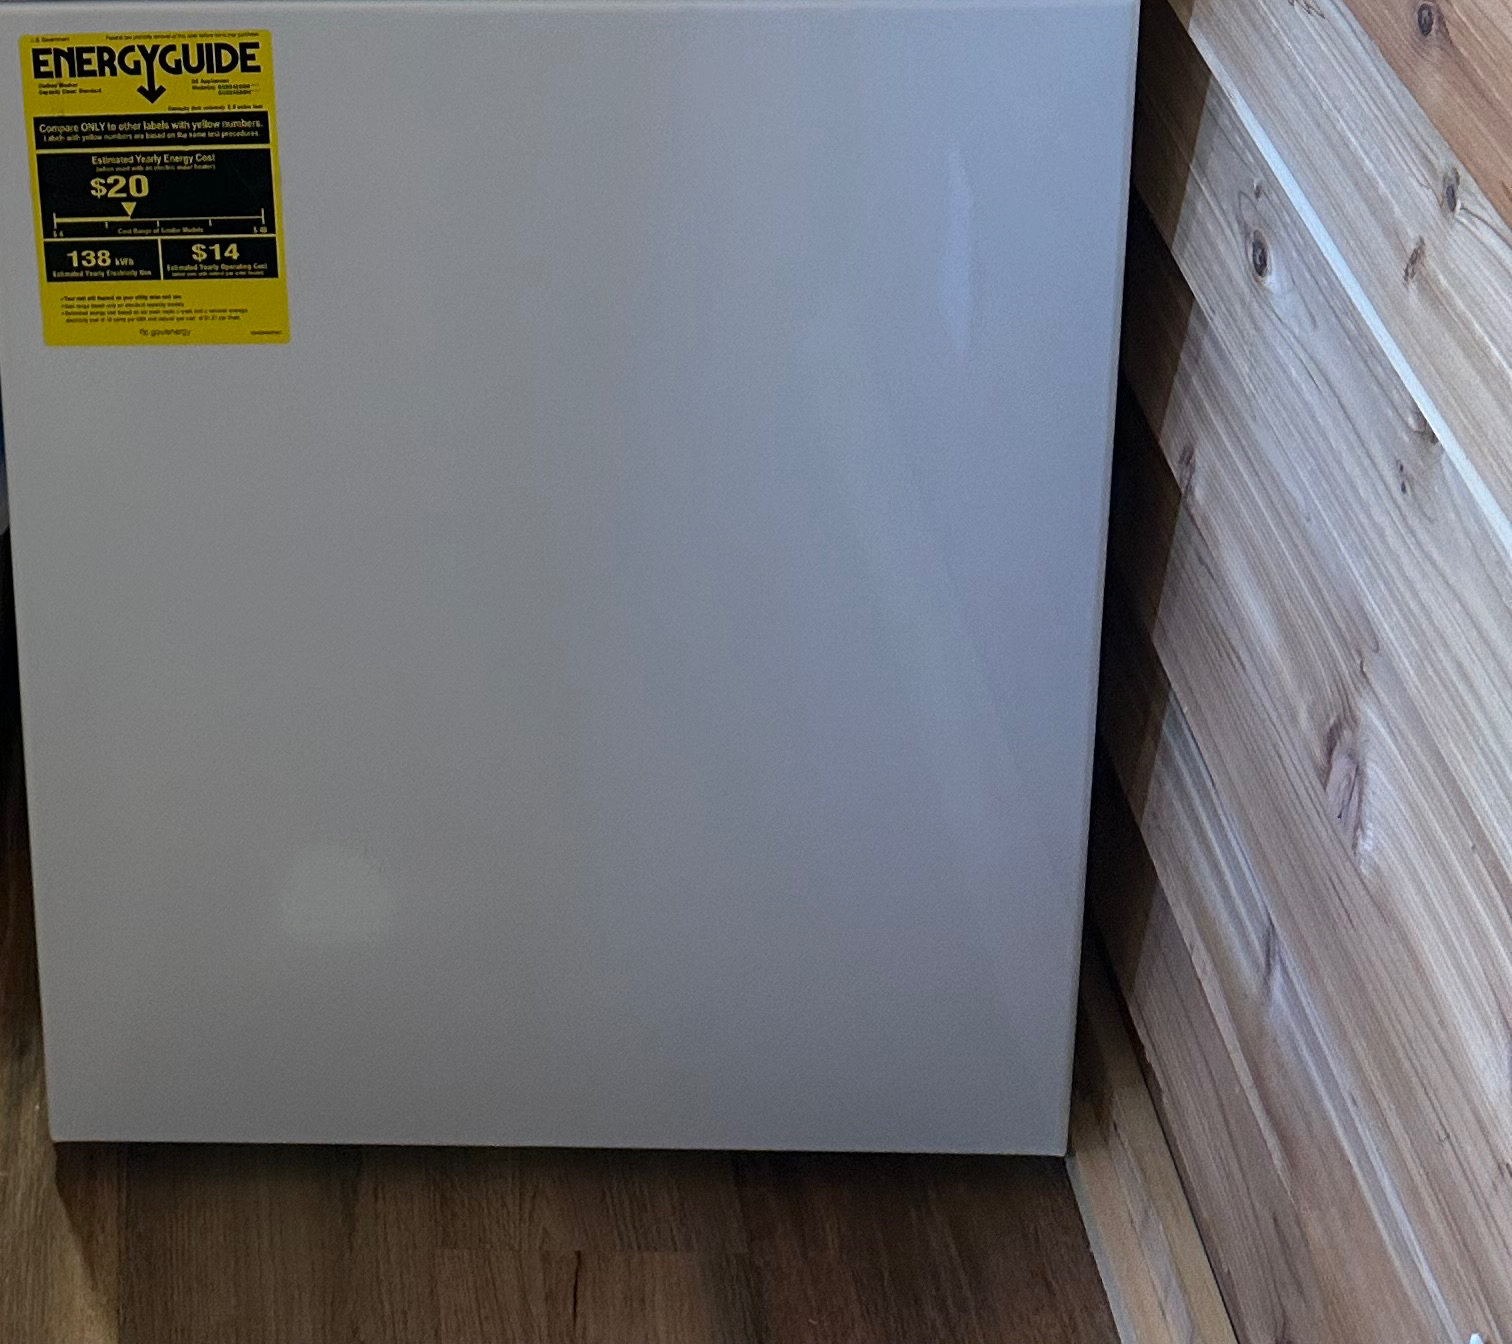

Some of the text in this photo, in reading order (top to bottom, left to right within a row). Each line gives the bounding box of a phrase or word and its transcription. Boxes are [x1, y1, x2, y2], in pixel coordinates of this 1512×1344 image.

[31, 42, 261, 79] ENERGYGUIDE
[39, 118, 264, 133] Compare ONLY to other labels with yellow numbers.
[91, 153, 216, 165] Estimated Yearly Energy Cost
[90, 175, 150, 199] $20
[66, 250, 135, 268] 138 kWh
[191, 243, 240, 262] $14
